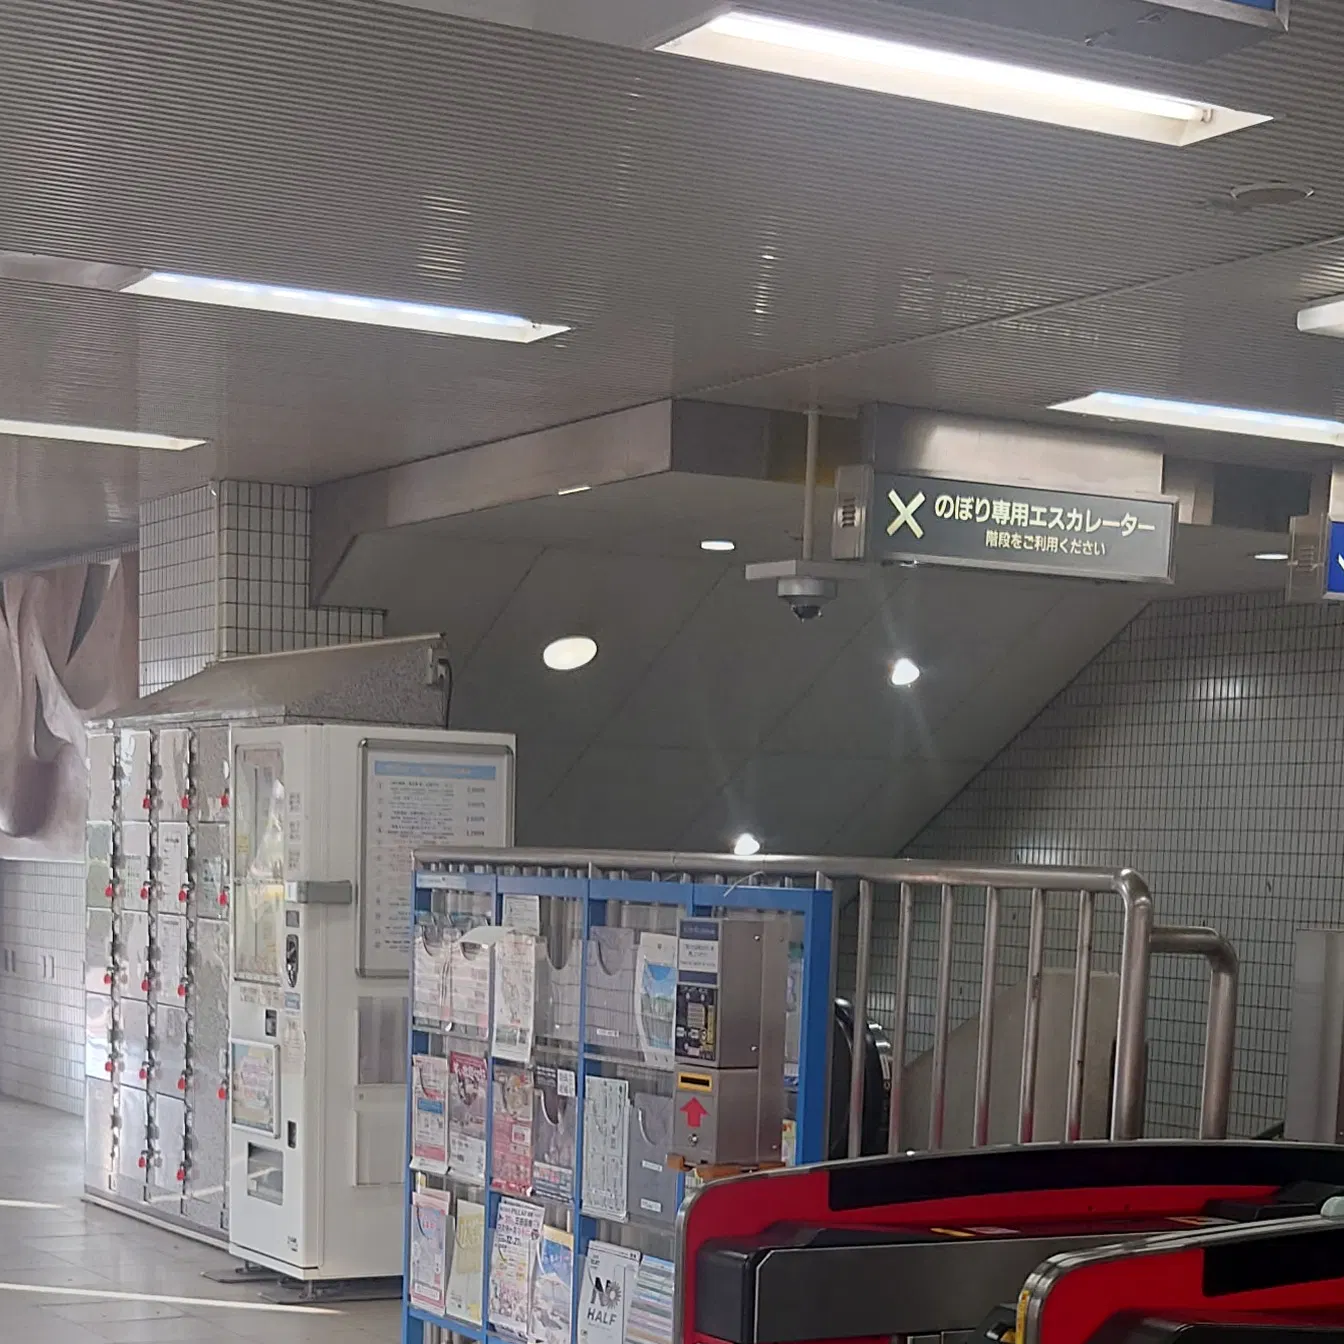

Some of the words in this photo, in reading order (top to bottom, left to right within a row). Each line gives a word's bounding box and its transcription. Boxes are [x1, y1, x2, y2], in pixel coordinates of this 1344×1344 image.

[934, 494, 1156, 537] のぼり専用エスカレーター
[985, 529, 1106, 556] 階段をご利用ください
[586, 1307, 617, 1326] HALF
